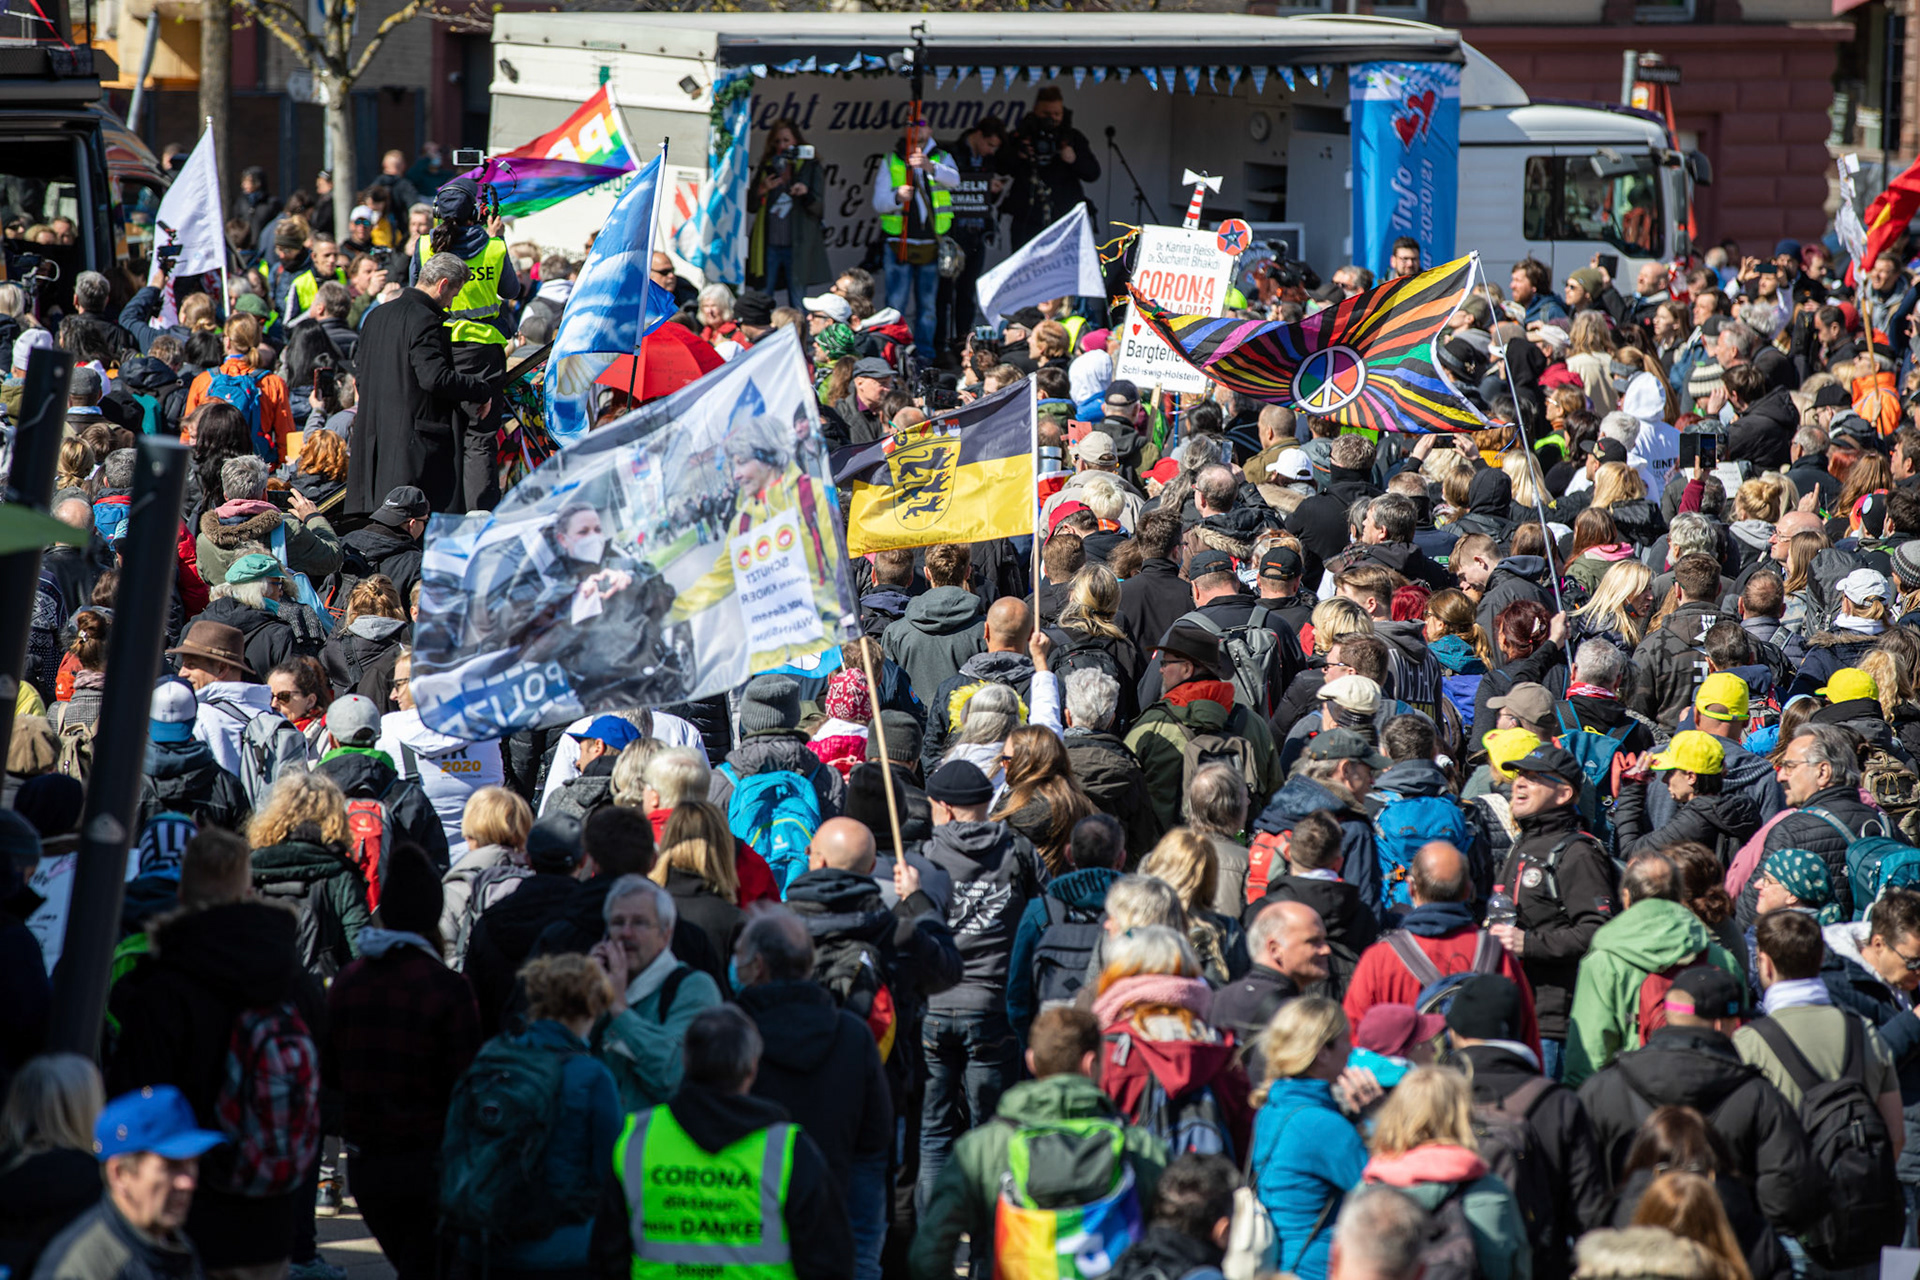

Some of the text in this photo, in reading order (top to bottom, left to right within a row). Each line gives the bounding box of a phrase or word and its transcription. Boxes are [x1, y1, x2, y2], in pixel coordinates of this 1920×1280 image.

[750, 91, 820, 130] teht
[1391, 166, 1419, 231] Info
[1156, 252, 1190, 266] Sucharit
[1165, 241, 1192, 254] Karina
[1193, 243, 1216, 257] Reiss
[468, 266, 494, 281] SSE
[1138, 269, 1216, 306] CORONA
[440, 760, 482, 774] 2020
[651, 1164, 753, 1188] CORONA
